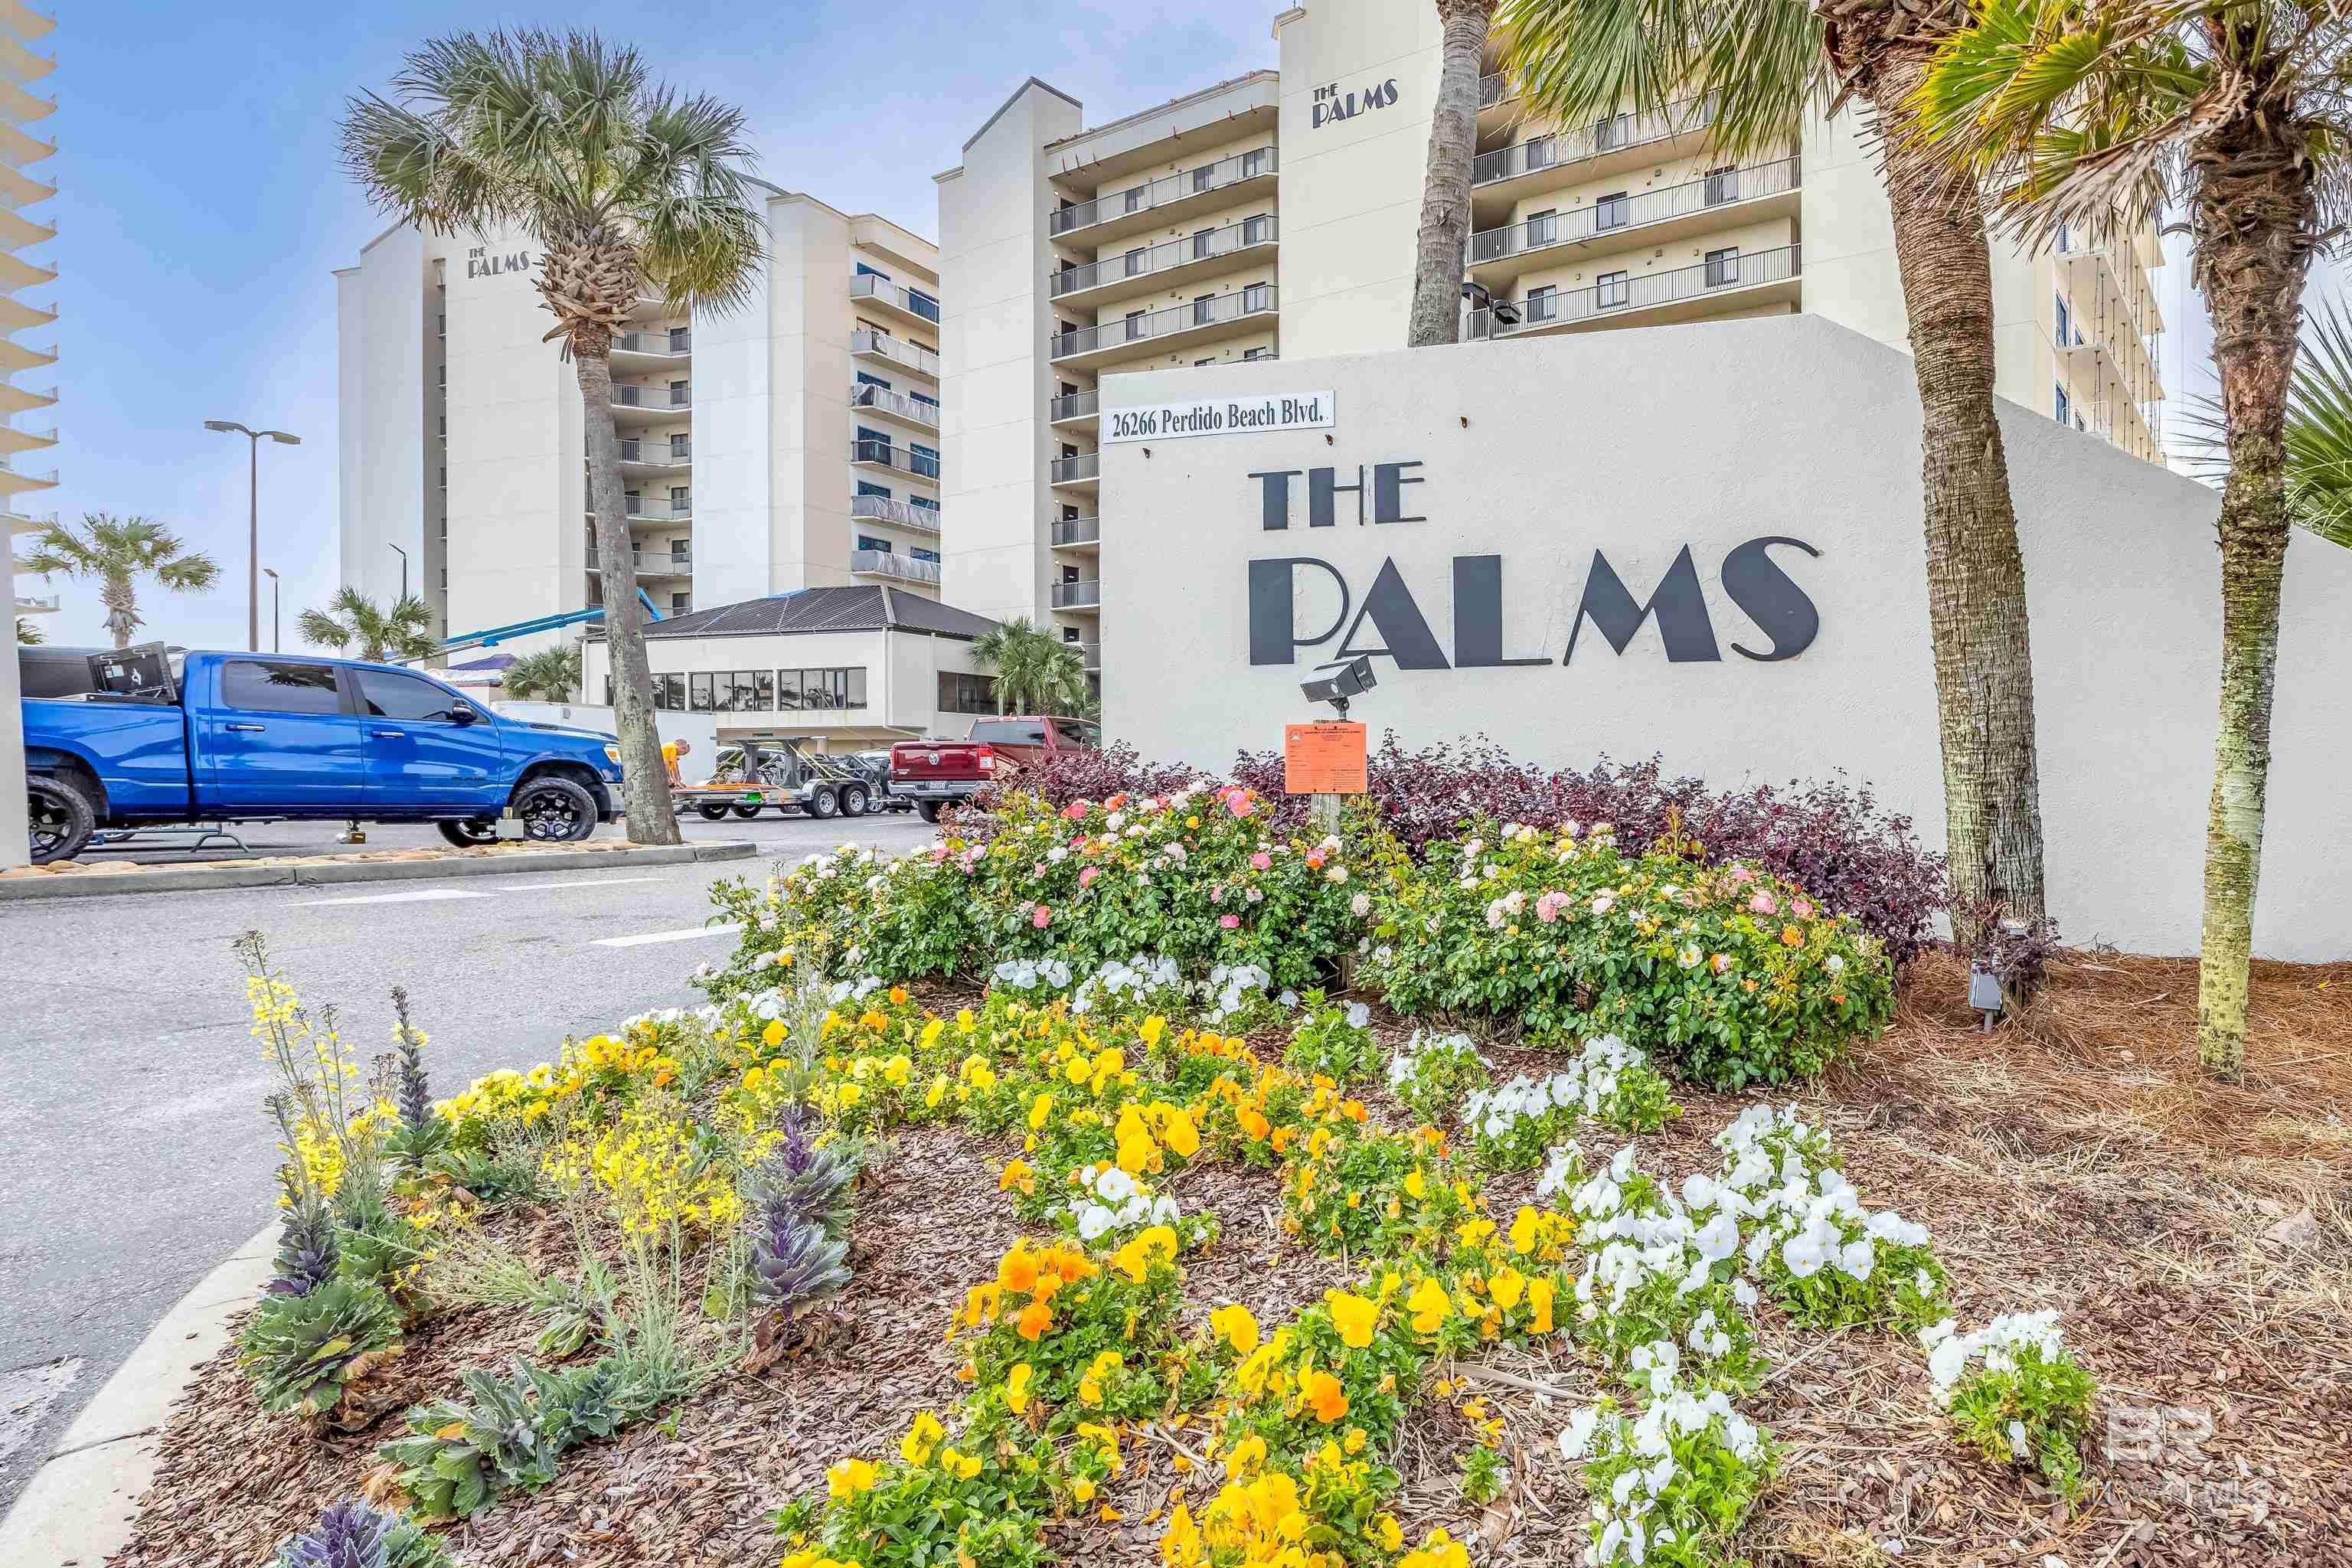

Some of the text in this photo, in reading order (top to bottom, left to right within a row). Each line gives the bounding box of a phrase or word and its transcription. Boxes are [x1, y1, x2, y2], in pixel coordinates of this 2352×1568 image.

[1312, 78, 1398, 129] PALMS
[1313, 83, 1338, 102] THE
[468, 250, 530, 279] PALMS
[469, 247, 485, 259] THE
[1112, 397, 1324, 437] 26266 Perdido Beach Blvd.
[1248, 461, 1427, 531] THE
[1248, 535, 1819, 671] PALMS
